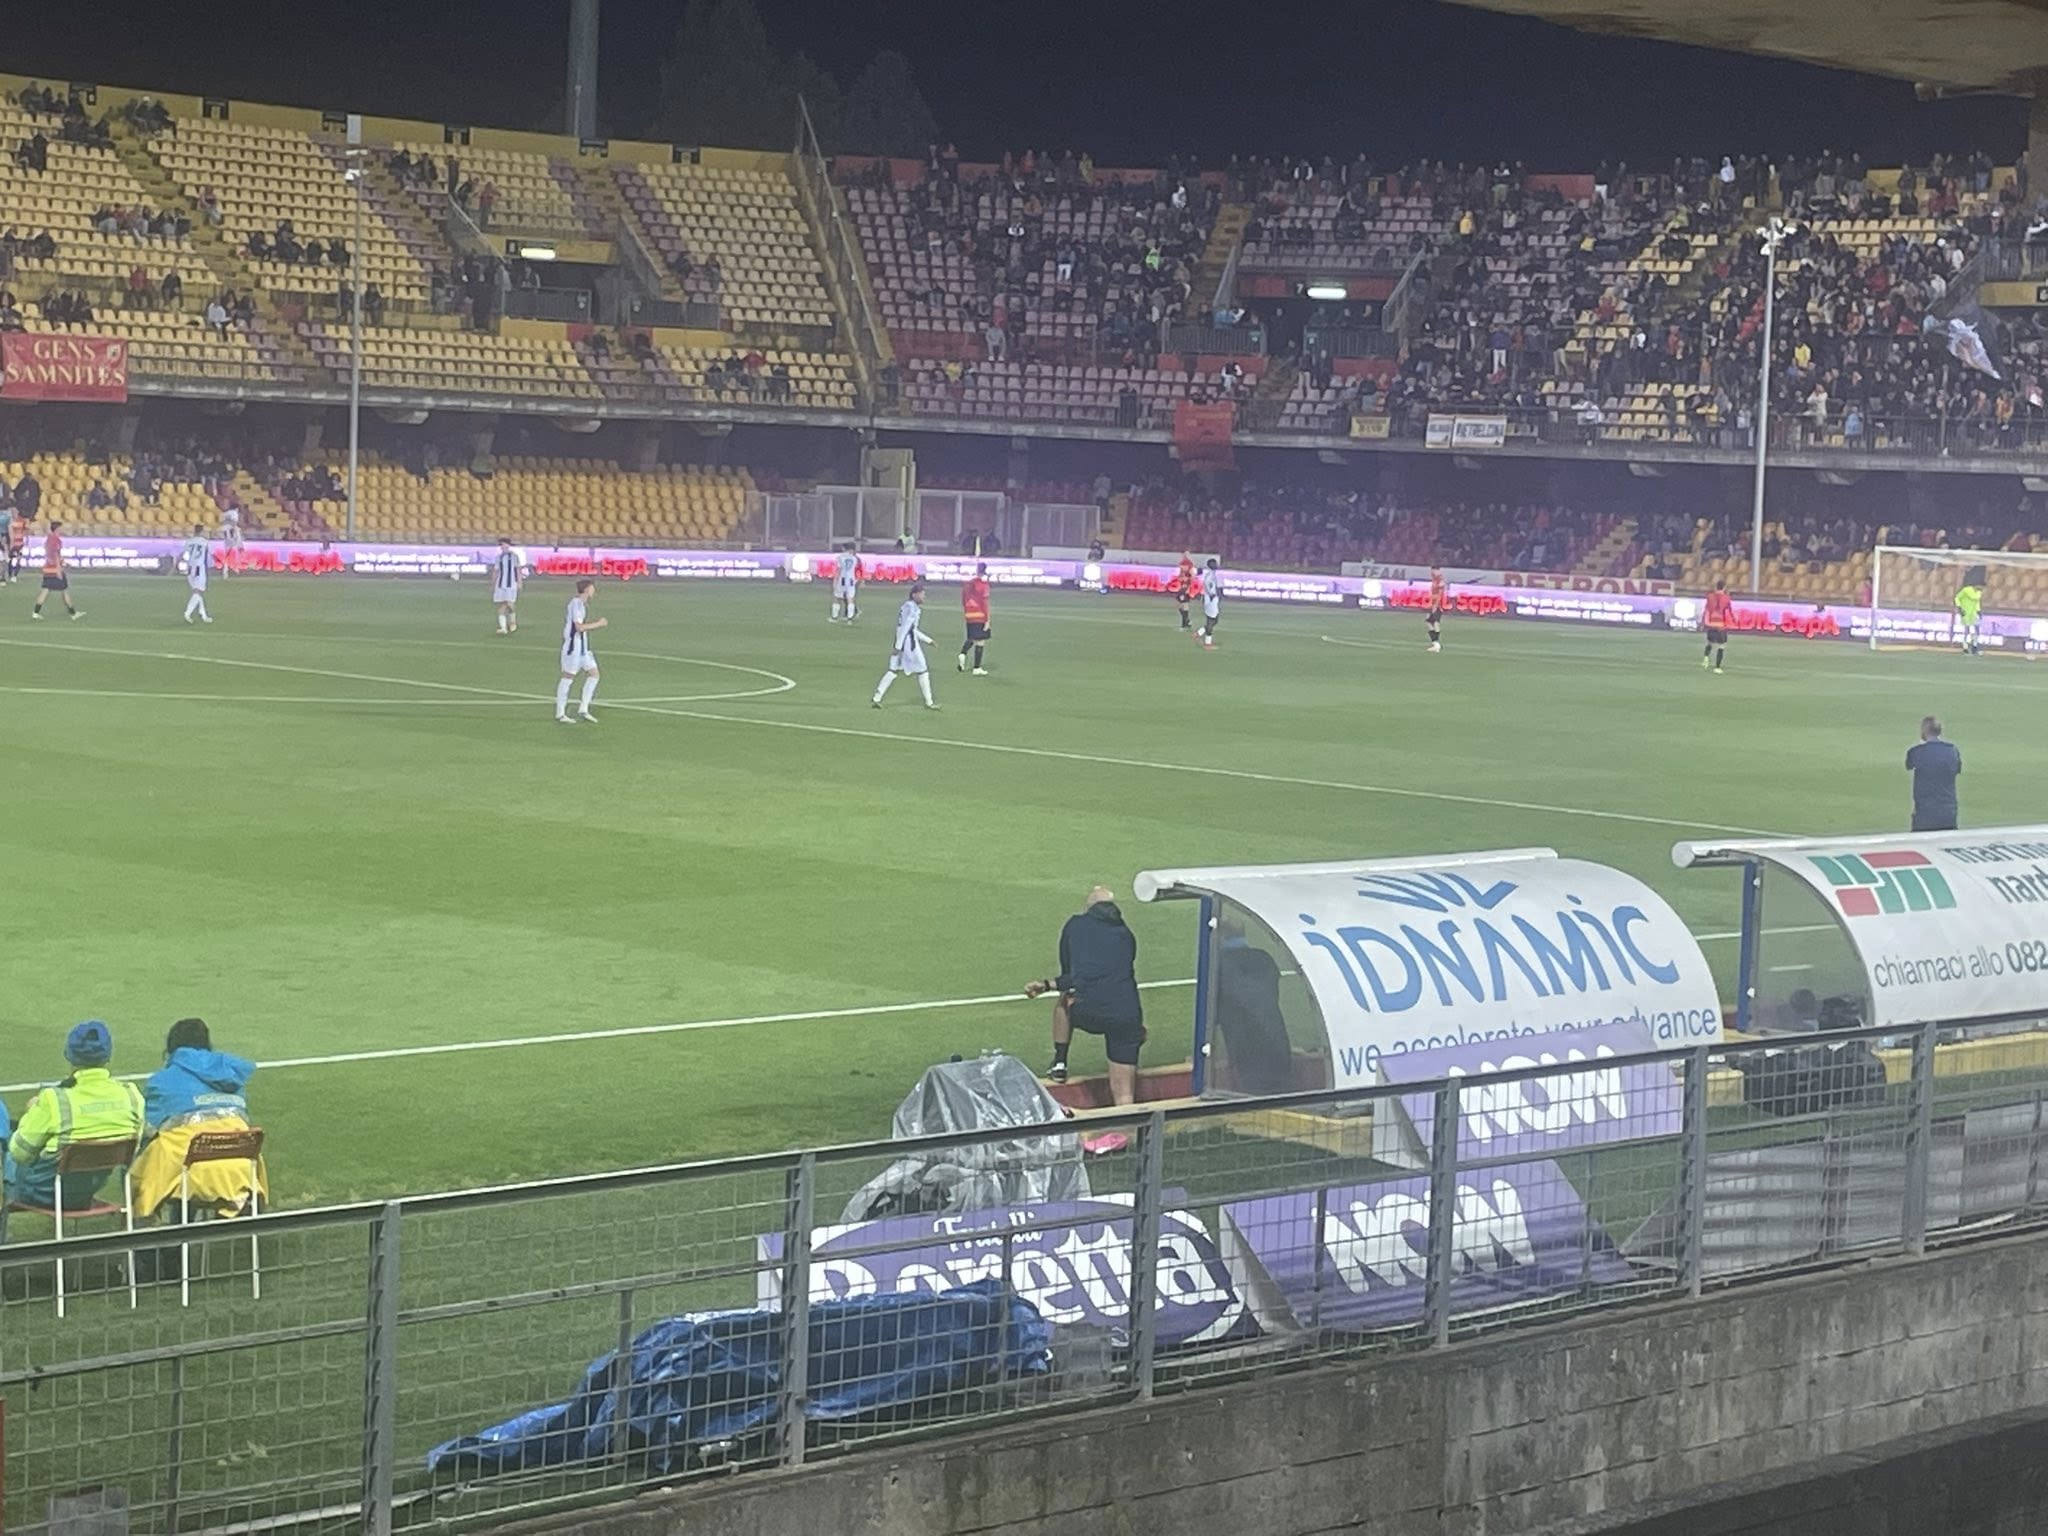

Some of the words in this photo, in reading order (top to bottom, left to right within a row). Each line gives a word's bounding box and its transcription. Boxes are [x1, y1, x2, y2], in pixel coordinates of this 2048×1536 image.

[33, 339, 96, 360] GENS
[6, 362, 126, 386] SAMNITES
[1874, 951, 1966, 988] chiamaci
[1968, 945, 2004, 978] allo
[1339, 1044, 1382, 1077] we
